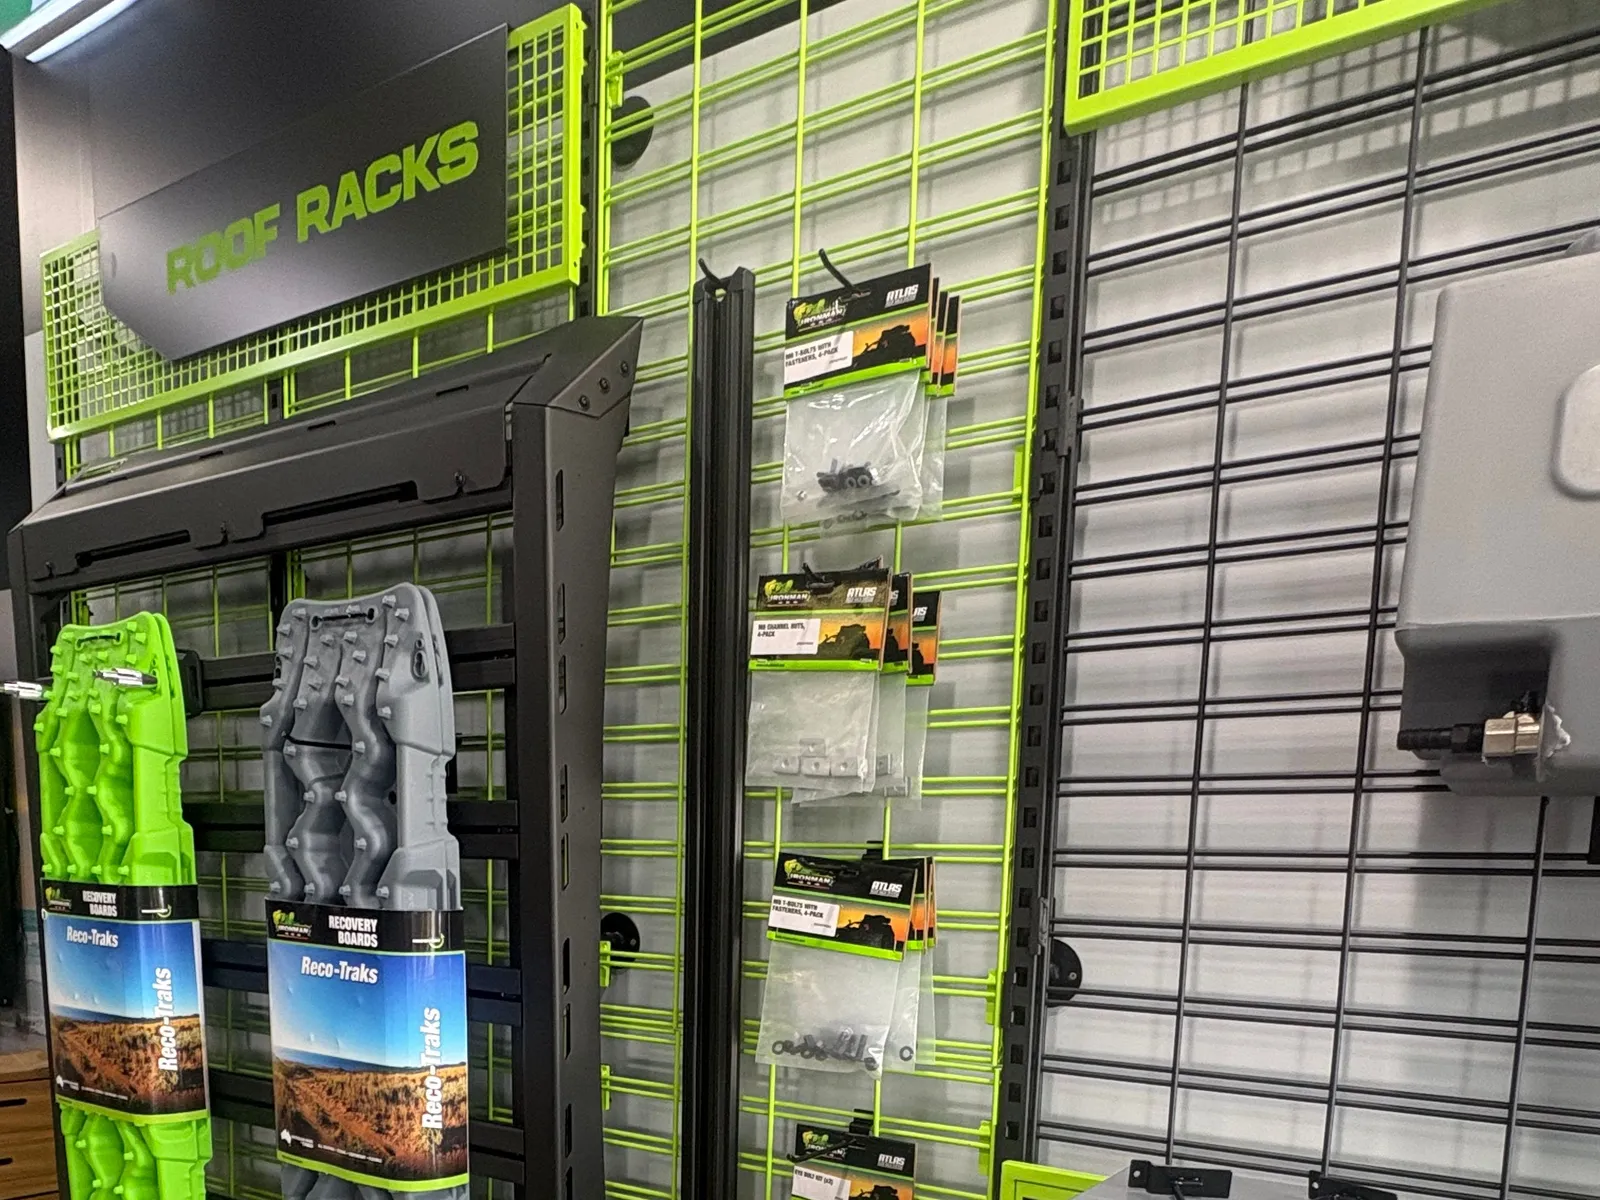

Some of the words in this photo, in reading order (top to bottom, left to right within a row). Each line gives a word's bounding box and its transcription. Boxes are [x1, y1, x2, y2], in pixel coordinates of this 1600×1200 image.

[167, 203, 280, 295] ROOF
[296, 120, 479, 243] RACKS
[885, 284, 919, 301] ATLAS
[818, 341, 832, 351] WITH
[846, 587, 877, 598] ATLAS
[789, 873, 831, 884] IRONMAN
[871, 881, 903, 892] ATLAS
[82, 890, 117, 904] RECOVERY
[783, 900, 803, 909] T-BOLTS
[89, 903, 118, 917] BOARDS
[328, 915, 378, 932] RECOVERY
[67, 926, 119, 948] Reco-Traks
[337, 931, 378, 948] BOARDS
[301, 956, 379, 984] Reco-Traks
[152, 967, 178, 1071] Reco-Traks
[420, 1007, 443, 1129] Reco-Traks
[879, 1154, 905, 1166] ATLAS
